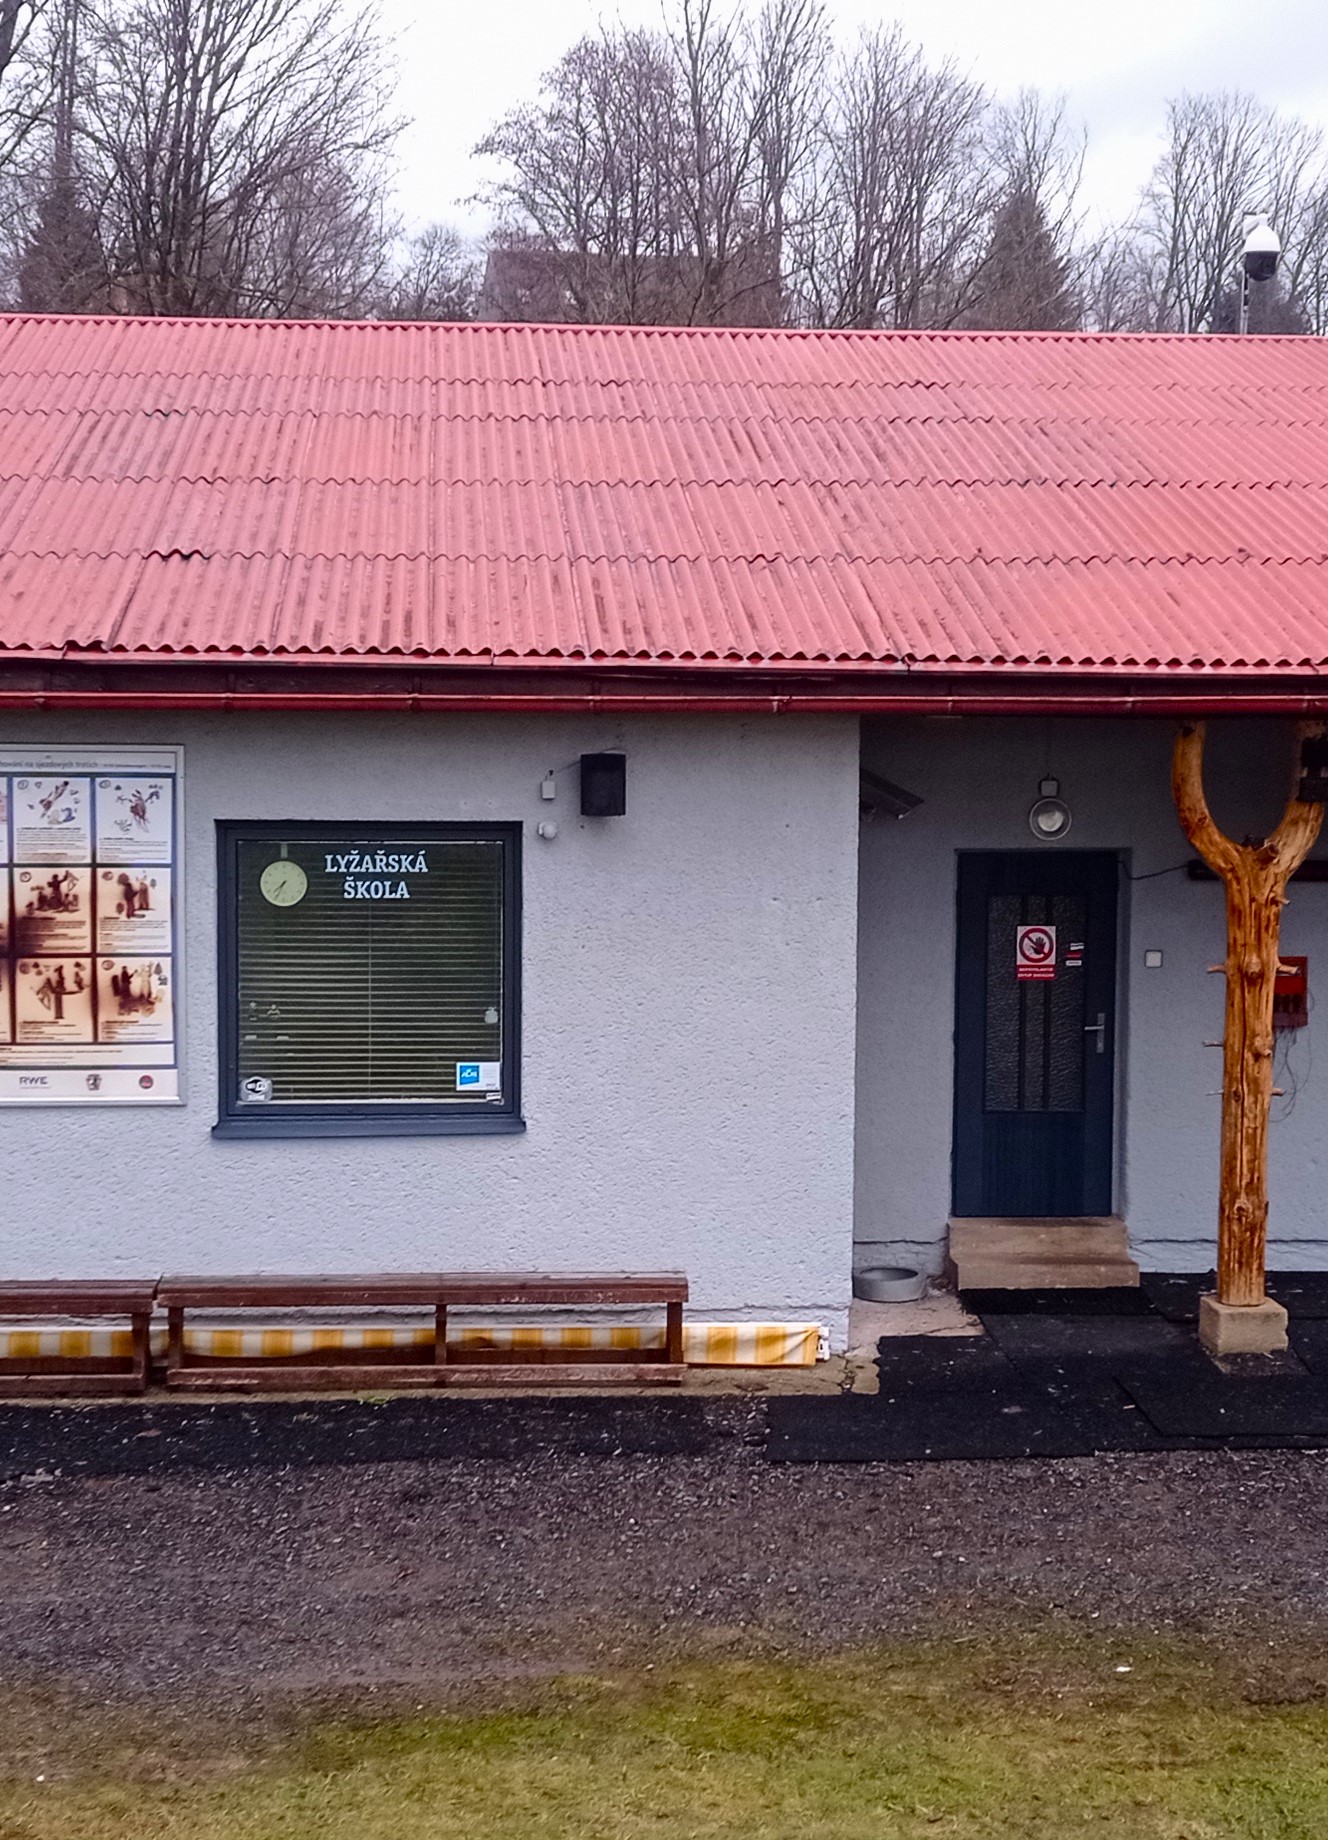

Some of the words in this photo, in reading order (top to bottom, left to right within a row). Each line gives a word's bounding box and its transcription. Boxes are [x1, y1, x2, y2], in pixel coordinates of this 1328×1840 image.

[325, 850, 428, 873] LYŽAŘSKÁ
[343, 876, 410, 899] ŠKOLA
[19, 1076, 48, 1085] RWE
